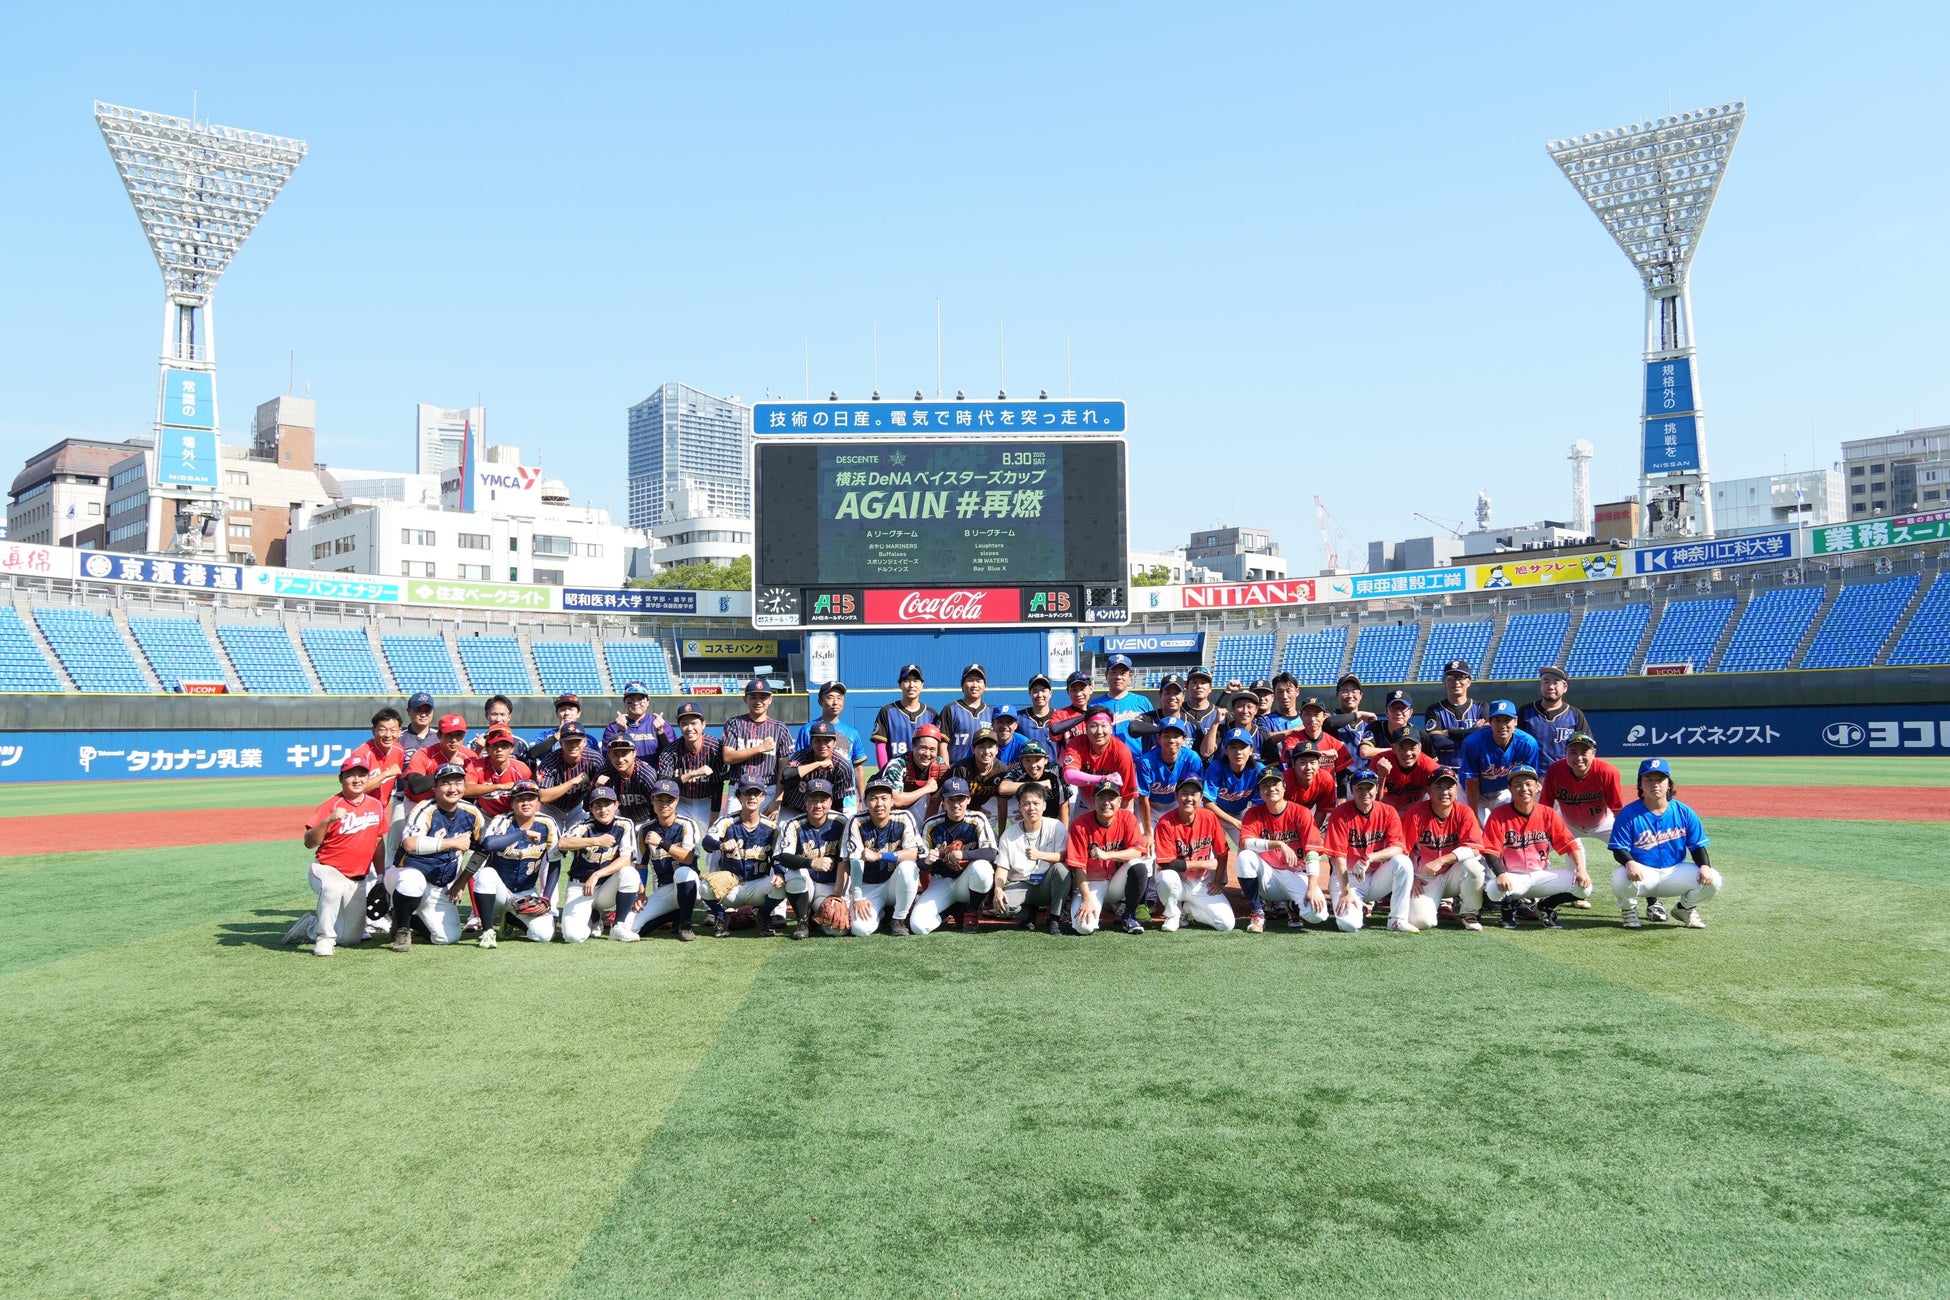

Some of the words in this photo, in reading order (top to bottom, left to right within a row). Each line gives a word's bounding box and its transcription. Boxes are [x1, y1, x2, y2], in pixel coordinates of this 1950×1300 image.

[1662, 364, 1676, 409] 規格外の
[769, 408, 1111, 428] 技術の日産。電気で時代を突っ走れ。
[1663, 422, 1678, 458] 挑戦を
[836, 455, 879, 464] DESCENTE
[1002, 452, 1032, 466] 8.30
[1653, 460, 1690, 469] NISSAN
[168, 473, 209, 483] NISSAN
[480, 473, 521, 490] YMCA
[834, 489, 949, 520] AGAIN
[1671, 536, 1784, 564] 神奈川工科大学
[1356, 573, 1462, 595] 東亜建設工業
[436, 585, 544, 606] 住友ベークライト
[564, 592, 643, 609] 昭和医科大学
[1184, 582, 1288, 608] NITTAN
[898, 590, 987, 621] Coca-Cola
[704, 643, 764, 655] コスモバンク
[1106, 637, 1158, 651] UYENO
[811, 648, 835, 660] Asahi
[954, 733, 970, 746] 17
[1651, 724, 1781, 745] レイズネクスト
[286, 743, 352, 768] キリン
[890, 742, 908, 755] 18
[126, 747, 264, 772] タカナシ乳業
[1538, 850, 1546, 862] 2
